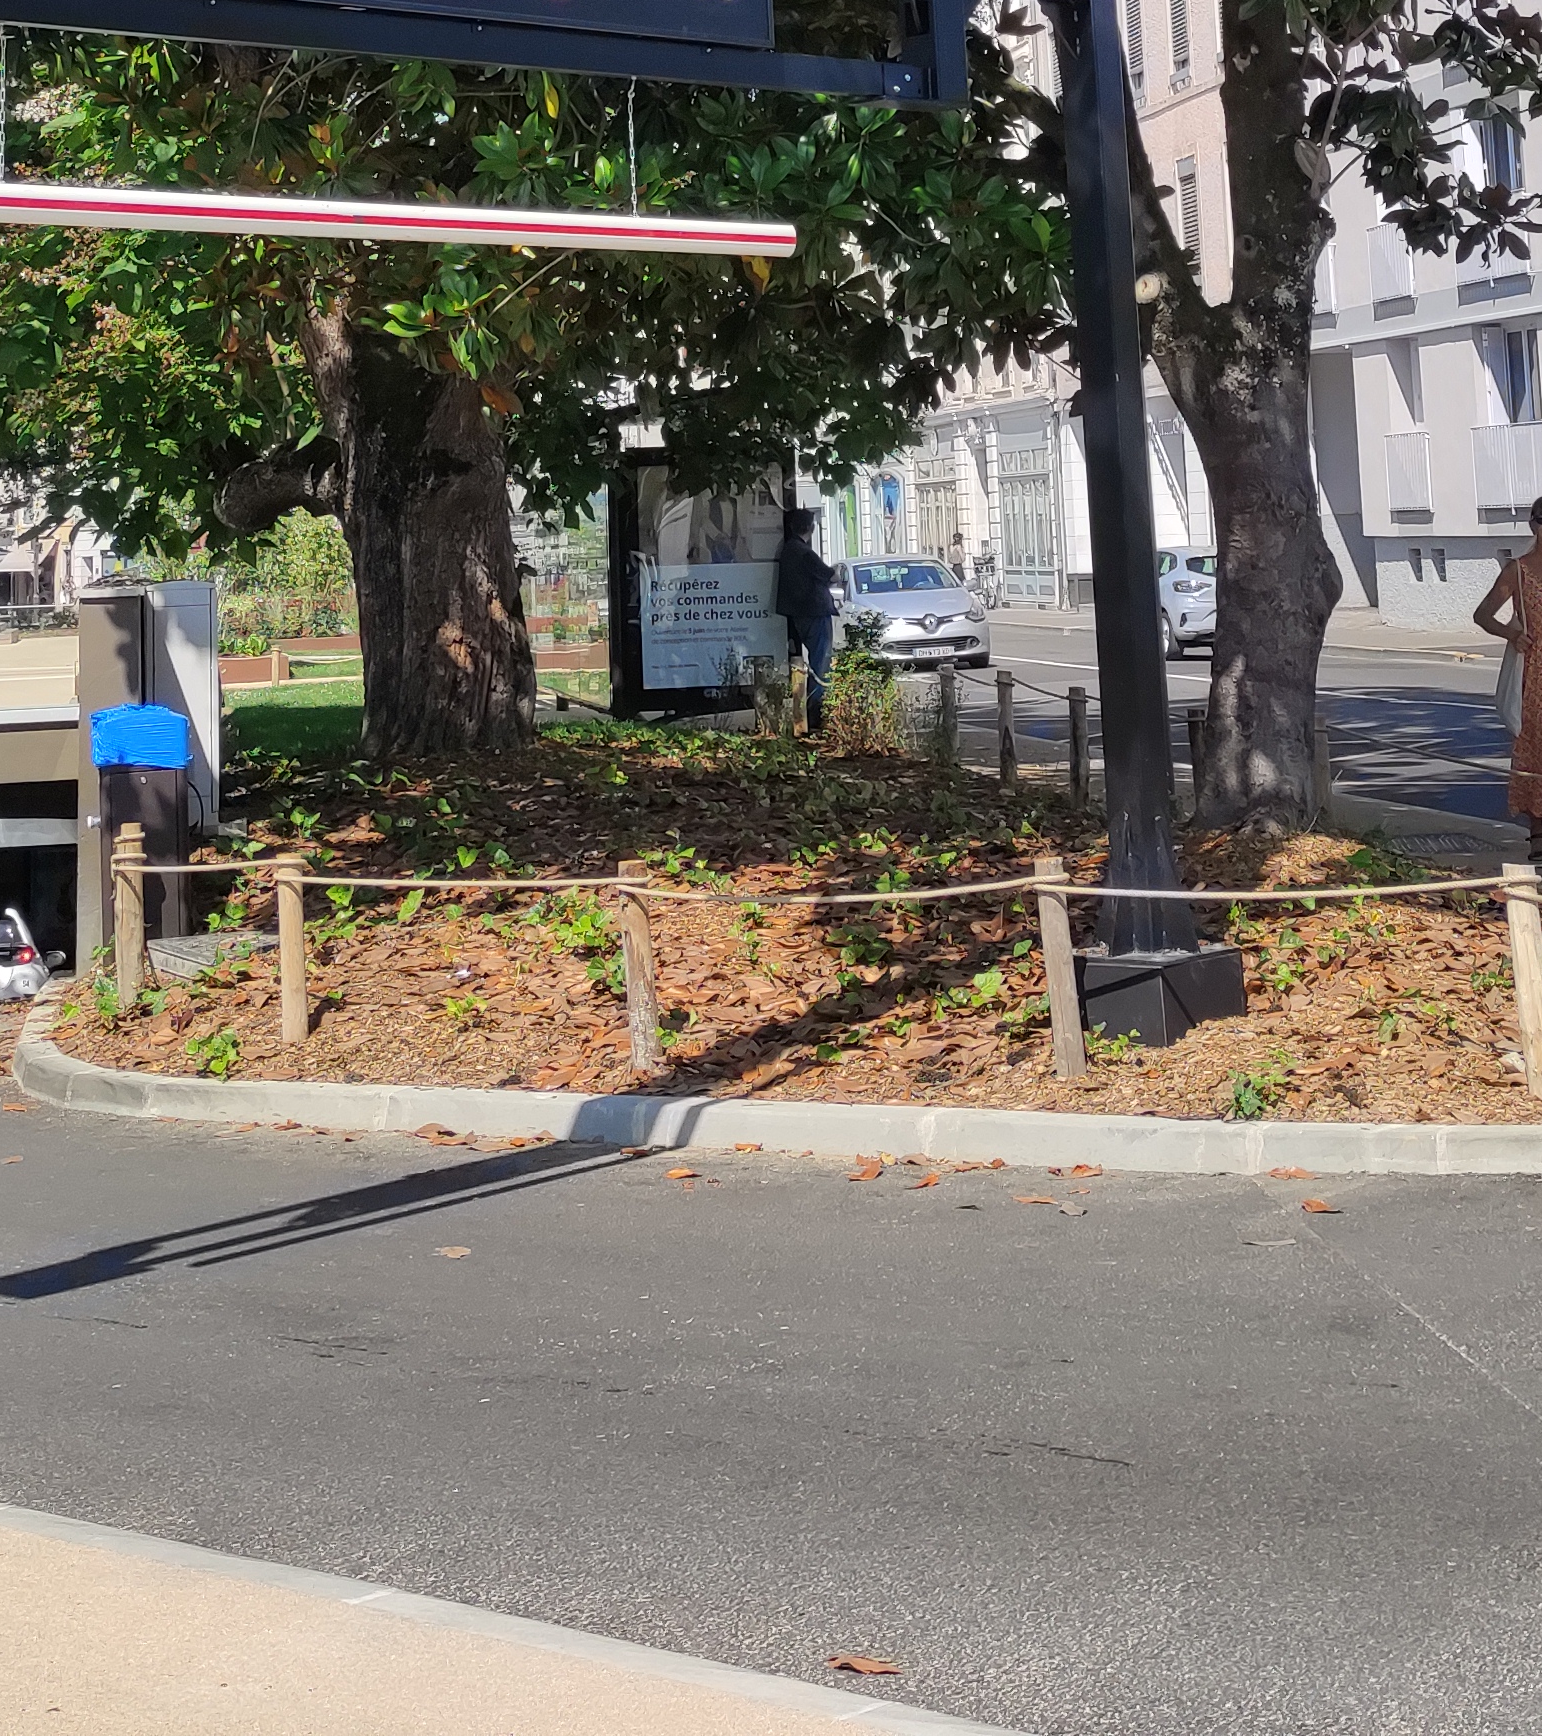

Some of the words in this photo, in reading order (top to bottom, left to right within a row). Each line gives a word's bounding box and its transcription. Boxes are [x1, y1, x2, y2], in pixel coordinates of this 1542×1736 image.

[651, 579, 720, 594] Récupérez
[651, 598, 674, 607] vos
[677, 593, 759, 606] commandes
[651, 609, 680, 626] près
[684, 609, 700, 621] de
[704, 609, 734, 621] chez
